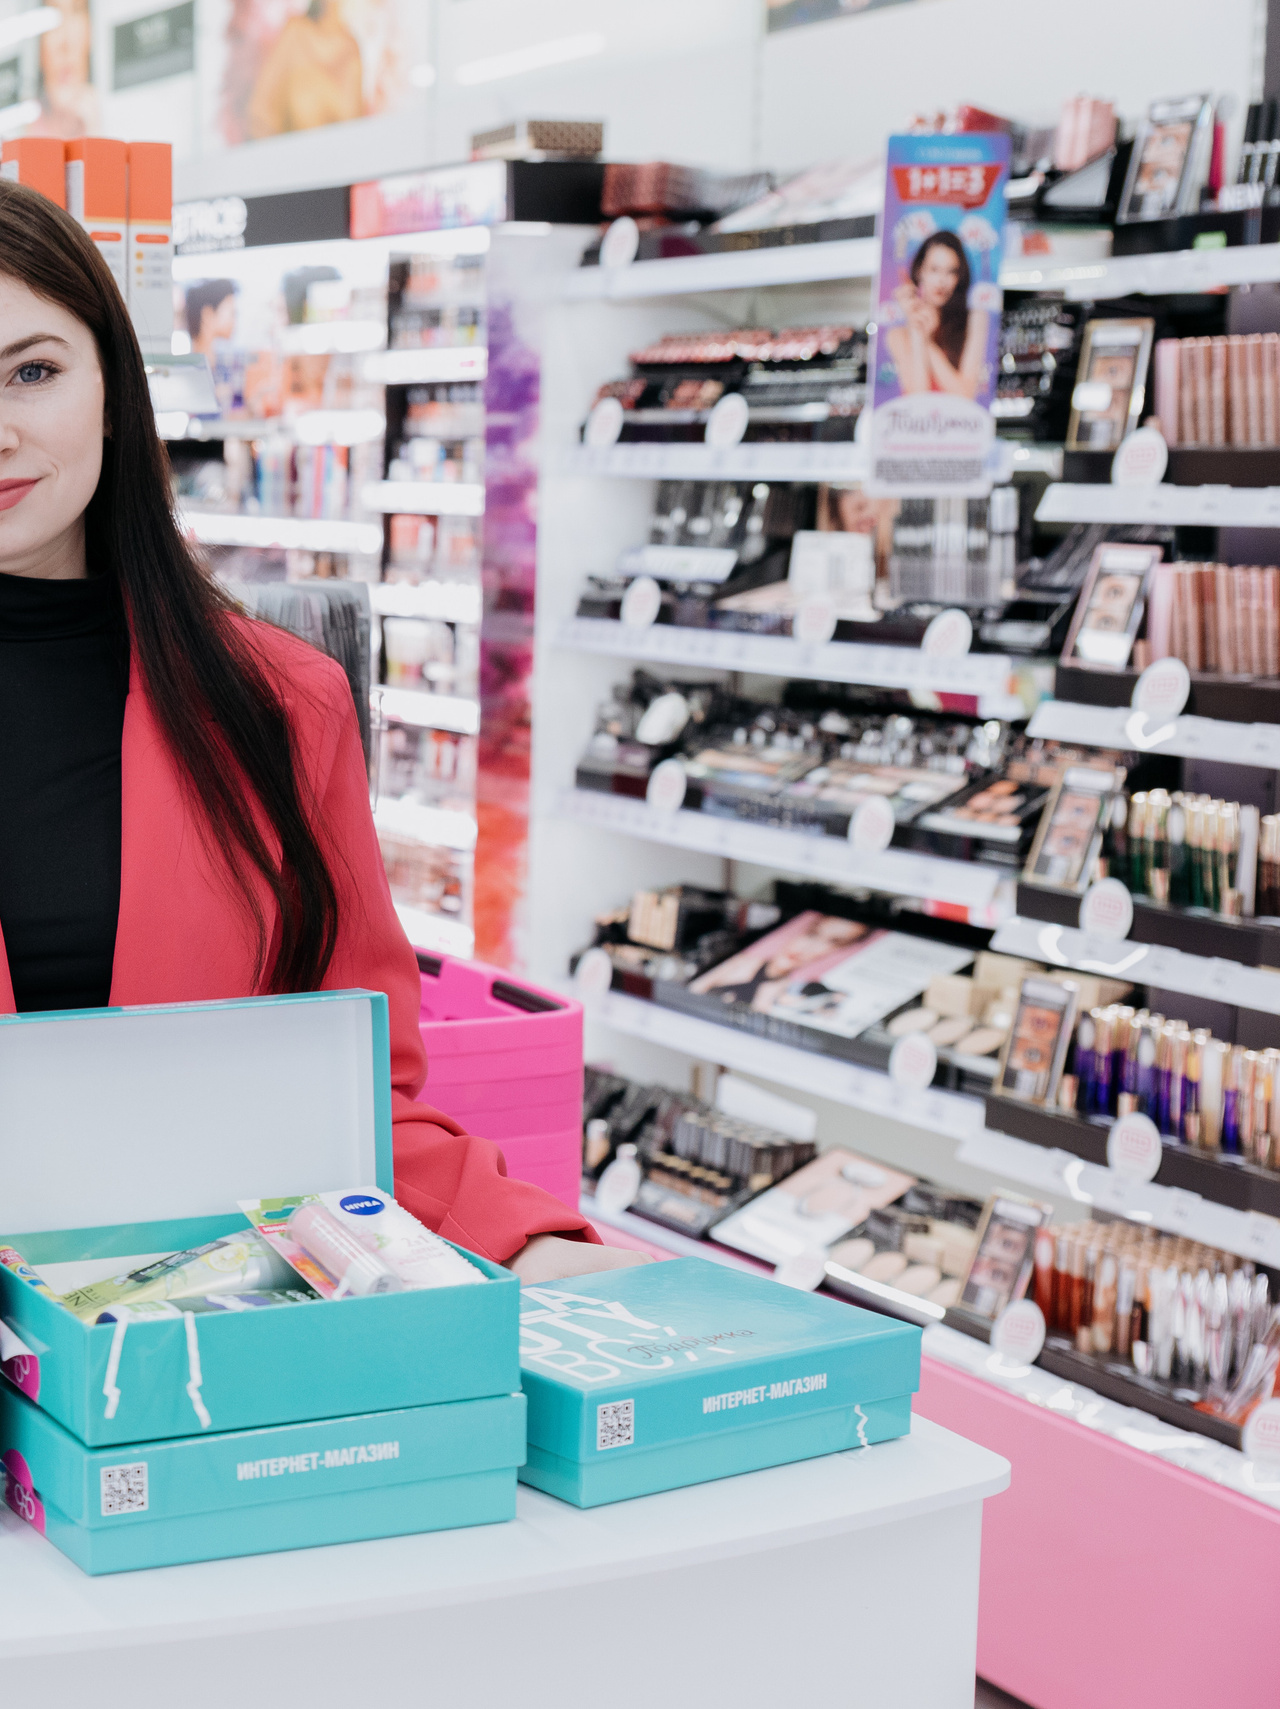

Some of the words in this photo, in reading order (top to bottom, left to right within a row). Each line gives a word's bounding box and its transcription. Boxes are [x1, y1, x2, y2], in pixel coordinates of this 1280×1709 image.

[344, 1199, 381, 1211] NIVEA
[627, 1328, 758, 1360] Подружка
[703, 1373, 828, 1414] ИНТЕРНЕТ-МАГАЗИН
[236, 1440, 400, 1481] ИНТЕРНЕТ-МАГАЗИН
